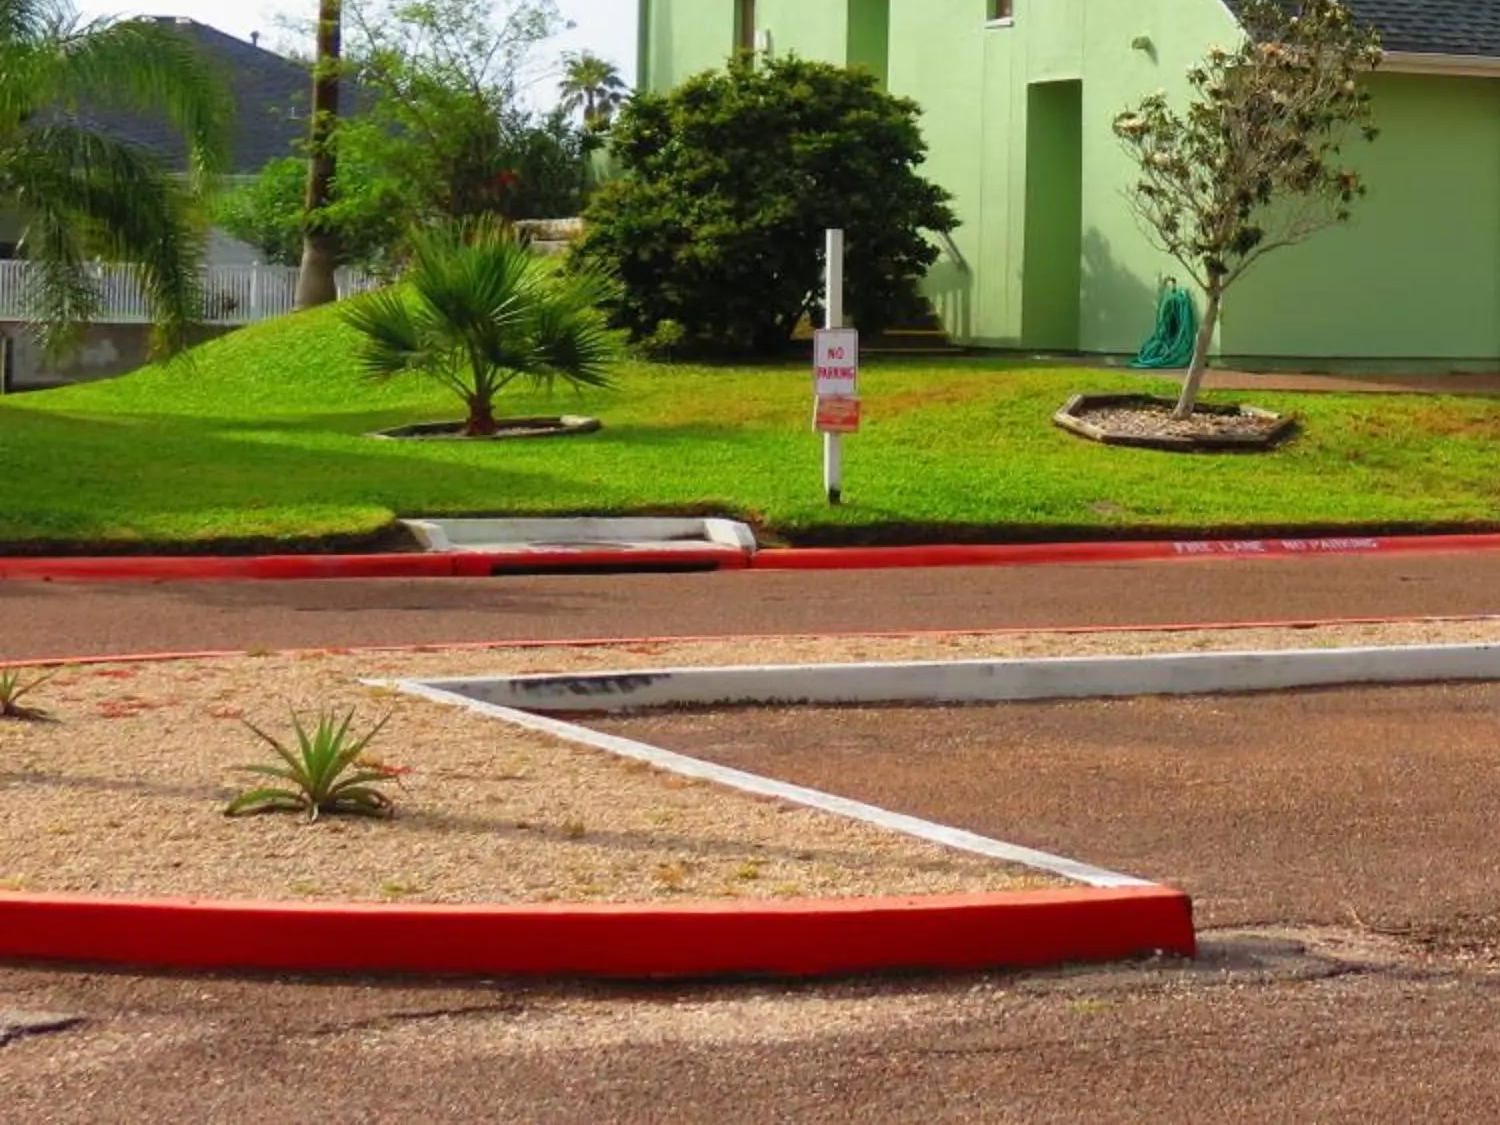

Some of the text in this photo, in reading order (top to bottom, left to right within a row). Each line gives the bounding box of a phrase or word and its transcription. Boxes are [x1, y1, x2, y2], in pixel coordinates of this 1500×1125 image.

[827, 347, 845, 360] NO
[816, 366, 855, 380] PARKING
[1173, 540, 1212, 553] FIRE
[1281, 539, 1306, 551] NO
[1309, 537, 1378, 550] PARKING
